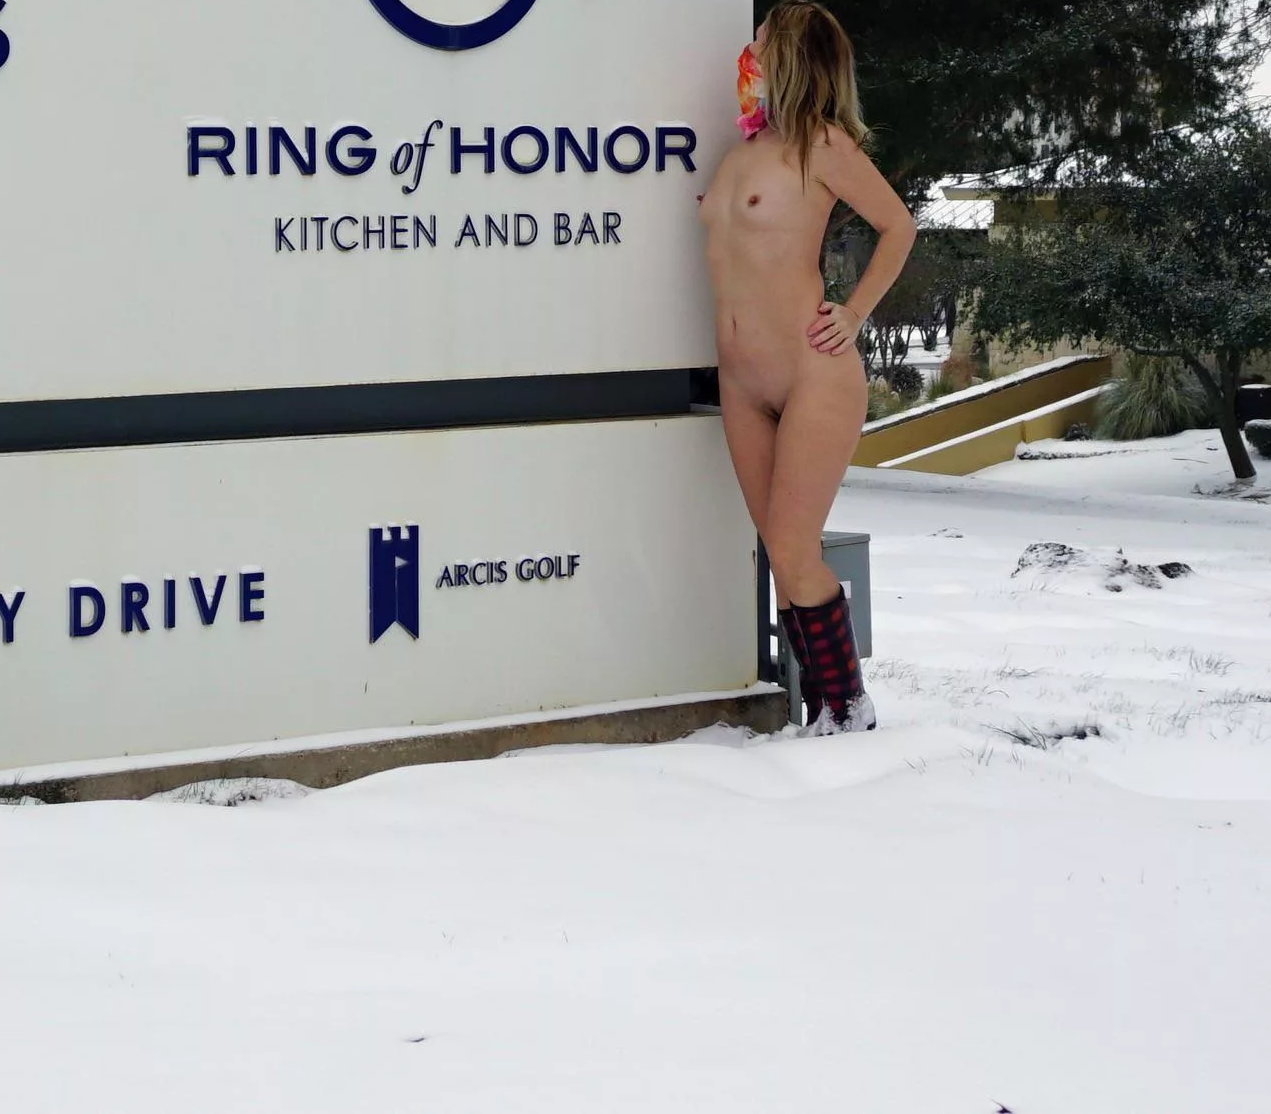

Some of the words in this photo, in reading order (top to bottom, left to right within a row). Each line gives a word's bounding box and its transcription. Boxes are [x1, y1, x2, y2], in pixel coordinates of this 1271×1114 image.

[186, 125, 378, 178] RING
[389, 119, 444, 196] of
[449, 125, 698, 175] HONOR
[274, 214, 437, 253] KITCHEN
[454, 213, 539, 248] AND
[553, 211, 623, 246] BAR
[435, 560, 508, 589] ARCIS
[514, 553, 581, 583] GOLF
[68, 571, 265, 639] DRIVE
